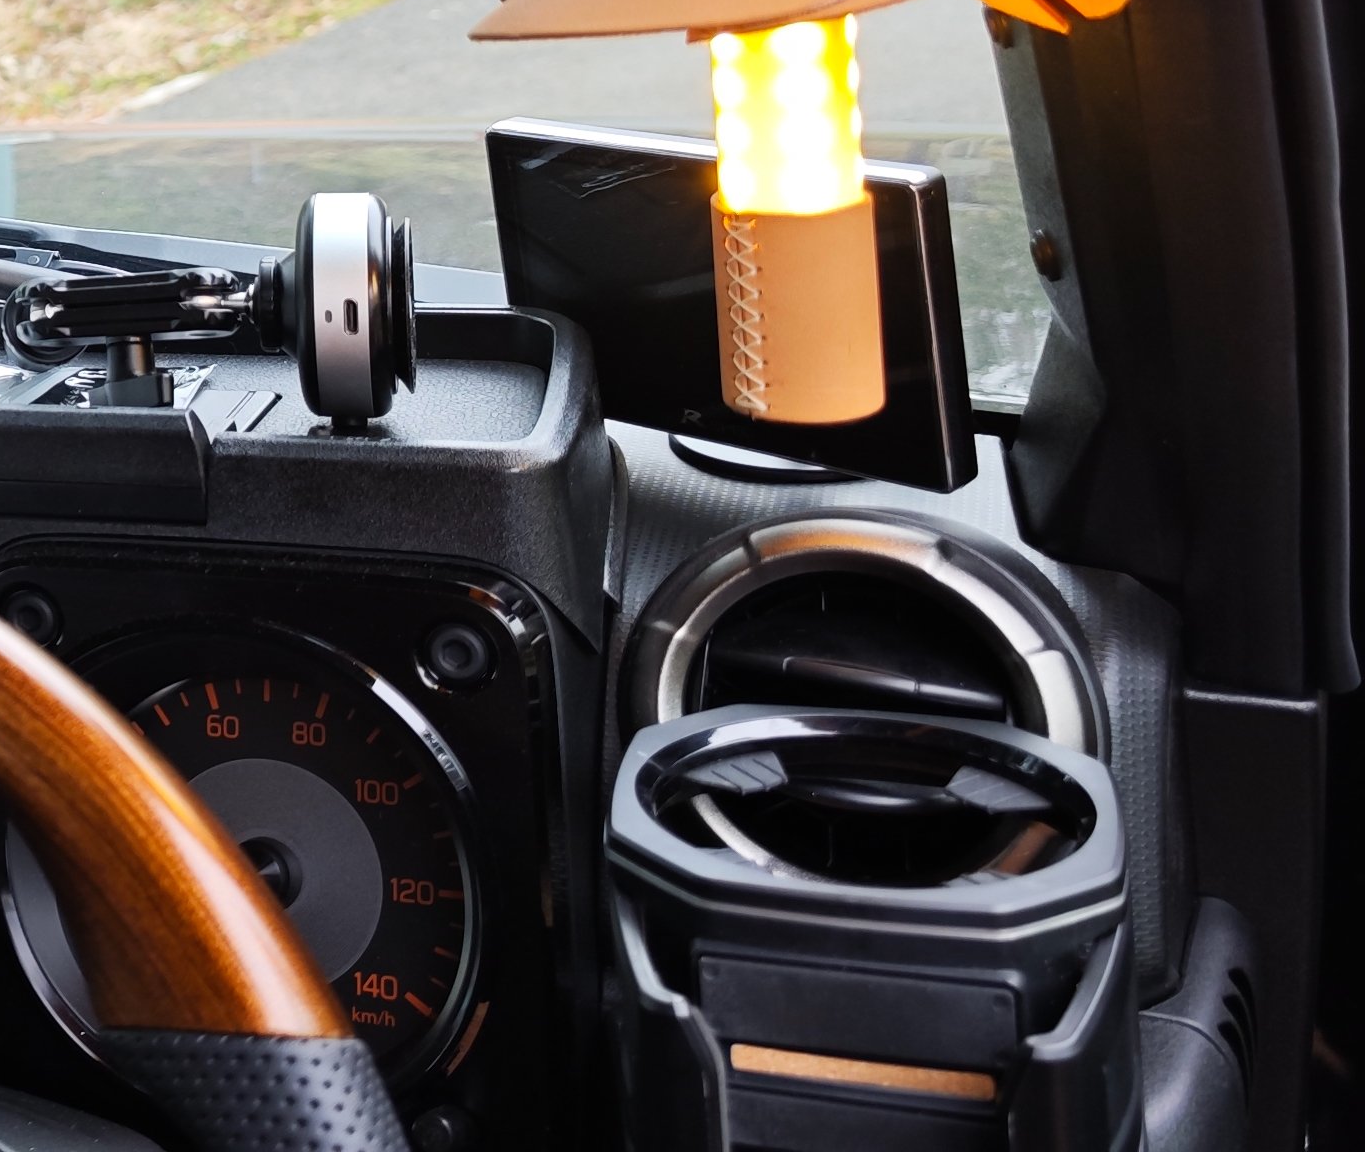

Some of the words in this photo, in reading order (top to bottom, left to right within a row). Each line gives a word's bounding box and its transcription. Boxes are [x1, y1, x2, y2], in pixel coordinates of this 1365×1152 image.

[205, 715, 241, 740] 60
[291, 721, 327, 747] 80
[355, 778, 400, 807] 100
[390, 877, 435, 906] 120
[353, 970, 399, 999] 140
[351, 1008, 397, 1028] km/h
